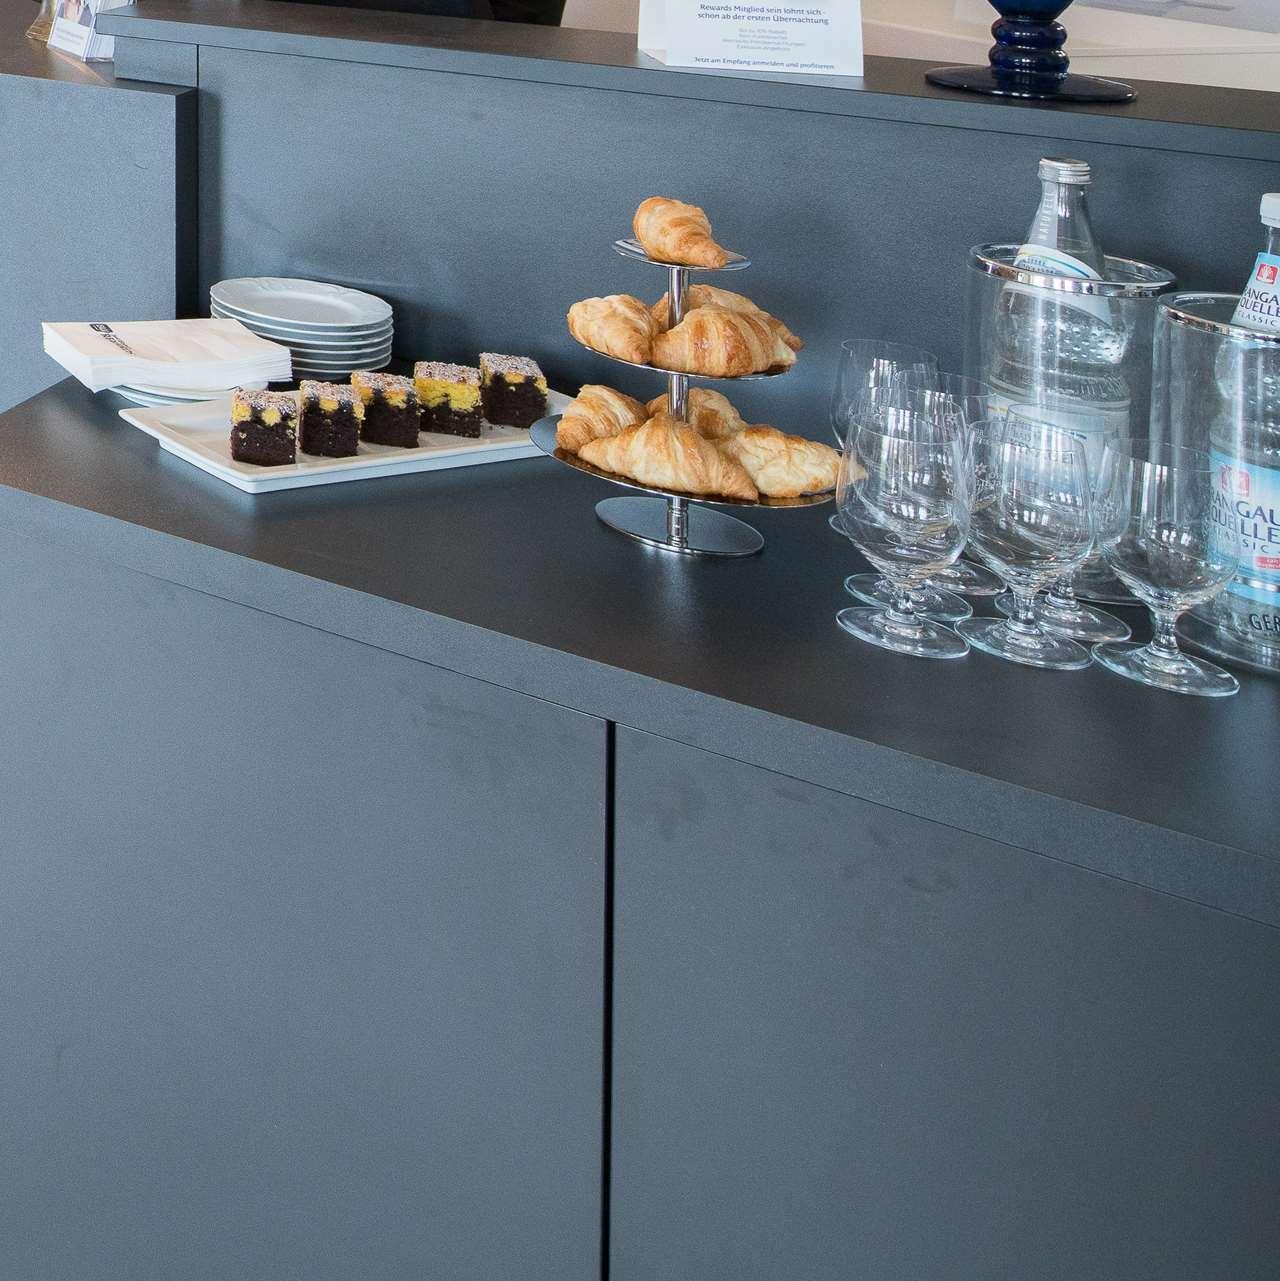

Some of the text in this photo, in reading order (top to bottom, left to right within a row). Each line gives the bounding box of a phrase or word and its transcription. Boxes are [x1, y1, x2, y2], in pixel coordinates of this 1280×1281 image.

[700, 4, 732, 12] Rewards
[734, 5, 765, 15] Mitglied
[806, 8, 821, 16] sich
[697, 12, 720, 20] schon
[746, 14, 771, 22] ersten
[722, 58, 751, 66] Empfang
